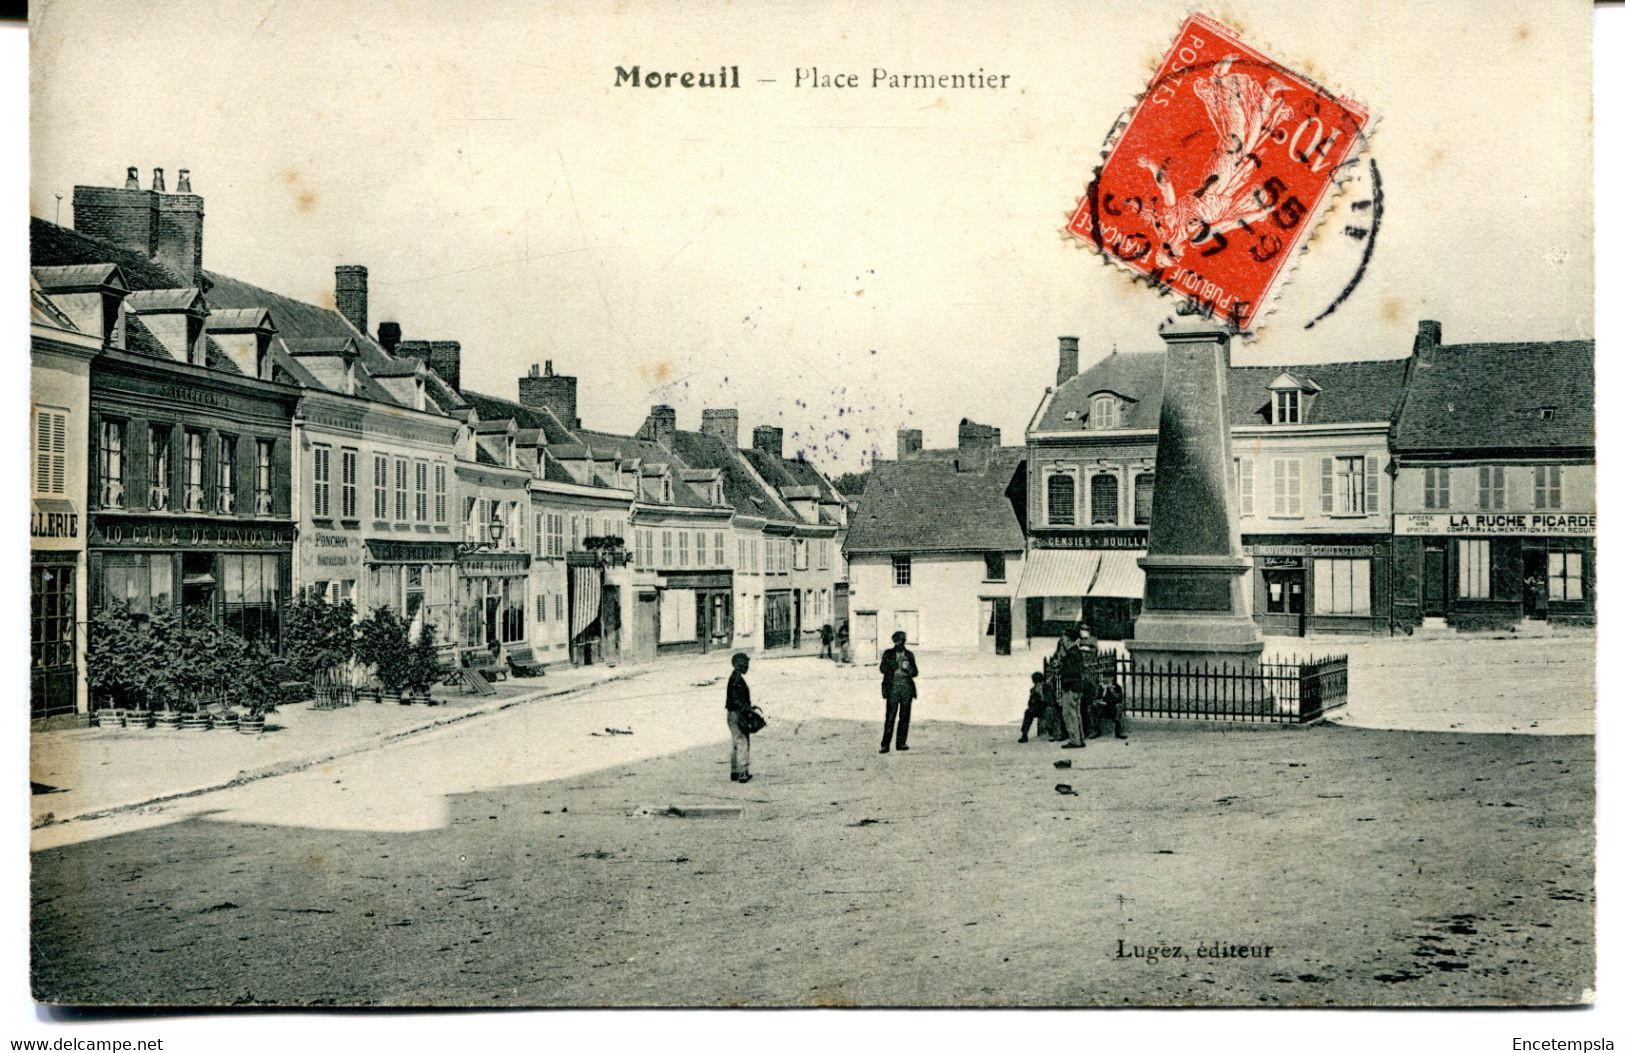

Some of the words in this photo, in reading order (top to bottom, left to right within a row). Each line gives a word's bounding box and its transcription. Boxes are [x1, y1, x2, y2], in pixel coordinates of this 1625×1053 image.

[613, 65, 742, 89] Moreuil
[794, 66, 859, 89] Place
[871, 66, 1011, 89] Parmentier
[1151, 33, 1204, 109] POSTES
[1449, 515, 1470, 527] LA
[1476, 515, 1527, 527] RUCHE
[1532, 515, 1597, 527] PICARDE
[1196, 940, 1275, 959] éditeur
